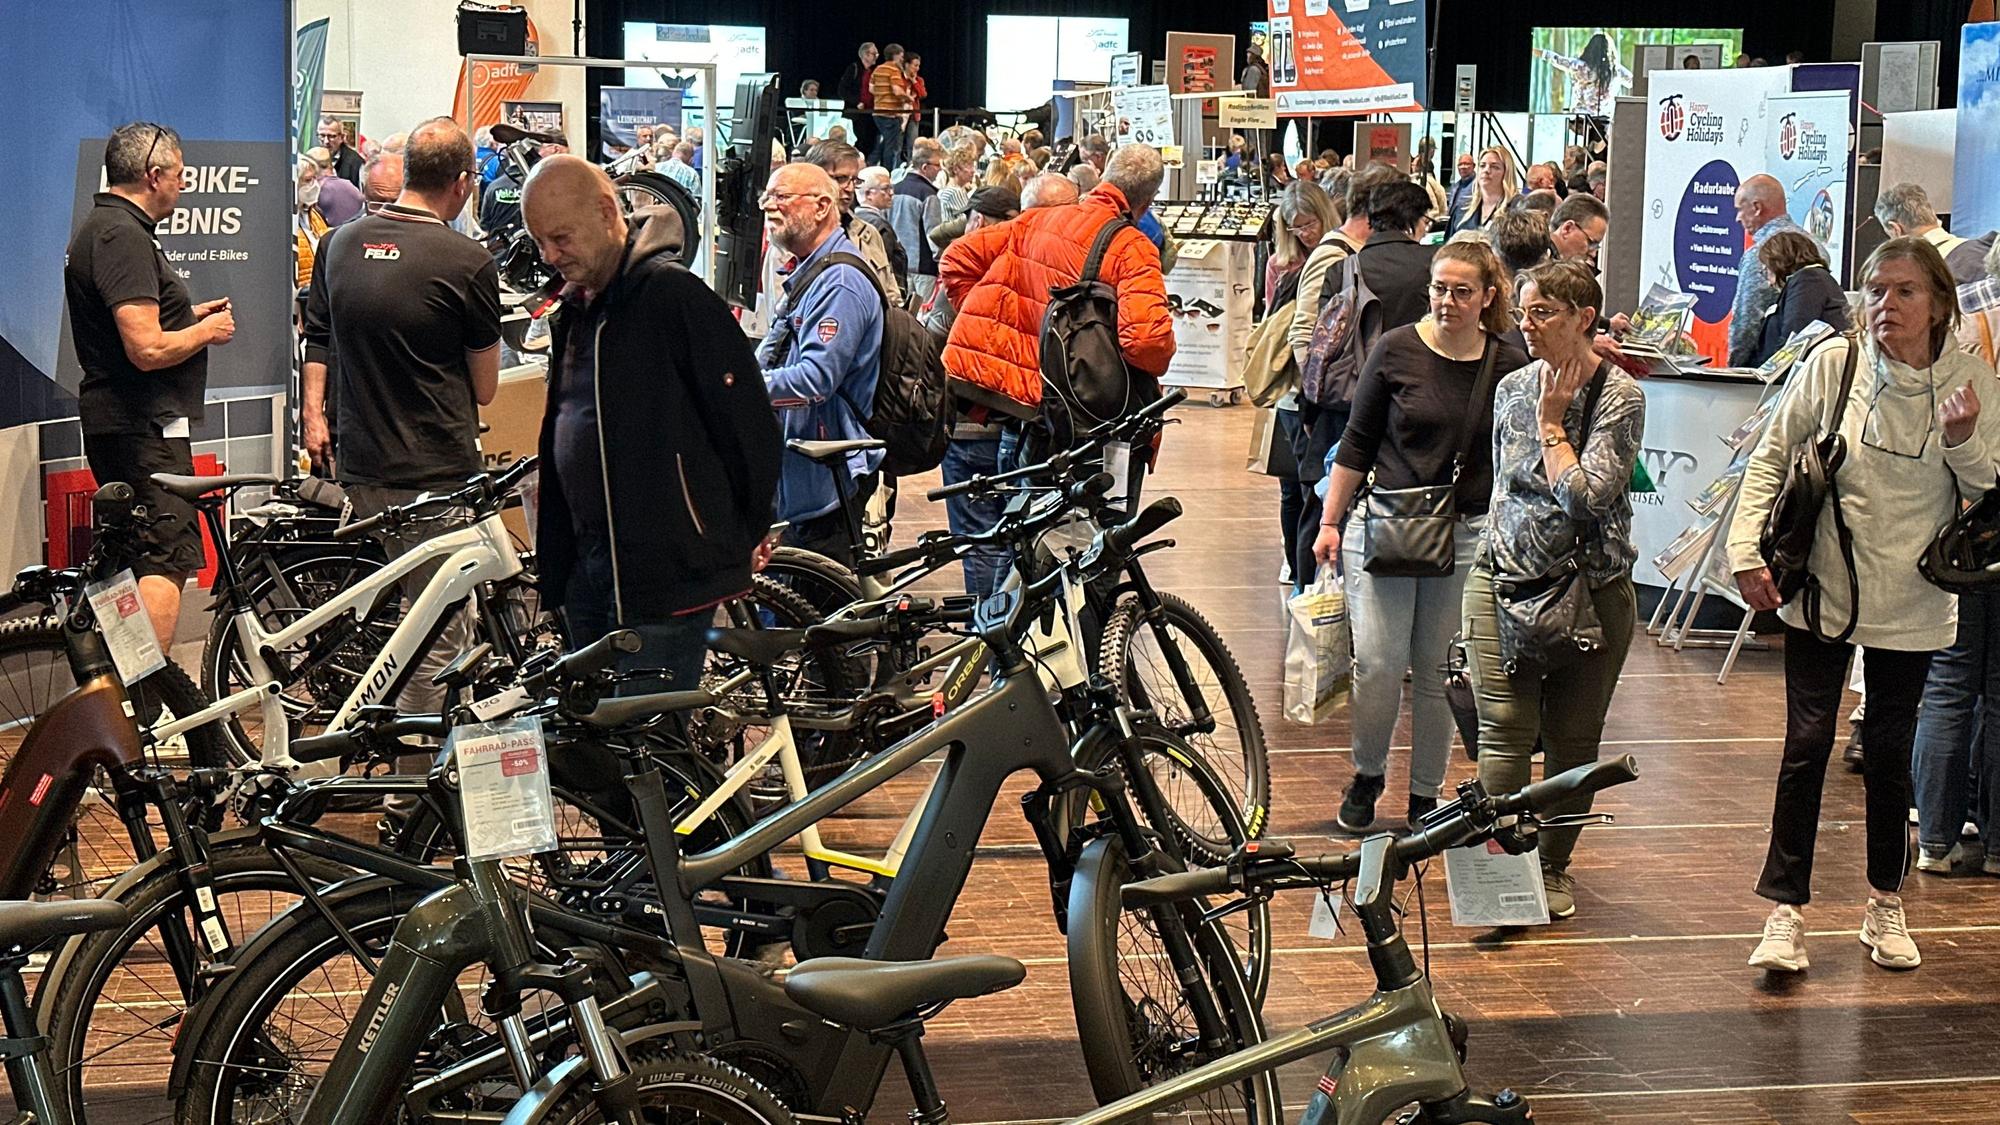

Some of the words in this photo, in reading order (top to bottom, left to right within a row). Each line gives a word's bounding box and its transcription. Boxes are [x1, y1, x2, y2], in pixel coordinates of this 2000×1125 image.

[1098, 40, 1118, 49] adfc
[491, 63, 522, 78] adfc
[1689, 101, 1708, 113] Happy
[1690, 112, 1723, 129] Cycling
[1800, 120, 1816, 129] Happy
[1686, 127, 1724, 146] Holidays
[1800, 131, 1827, 149] Cycling
[1797, 146, 1828, 164] Holidays
[188, 250, 207, 261] und
[209, 249, 249, 261] E-Bikes
[948, 641, 987, 701] ORBEA
[463, 737, 536, 756] FAHRRAD-PASS
[511, 759, 529, 767] -50%
[357, 982, 400, 1053] KETTLER
[649, 1072, 686, 1083] SAM
[691, 1074, 748, 1100] SMART
